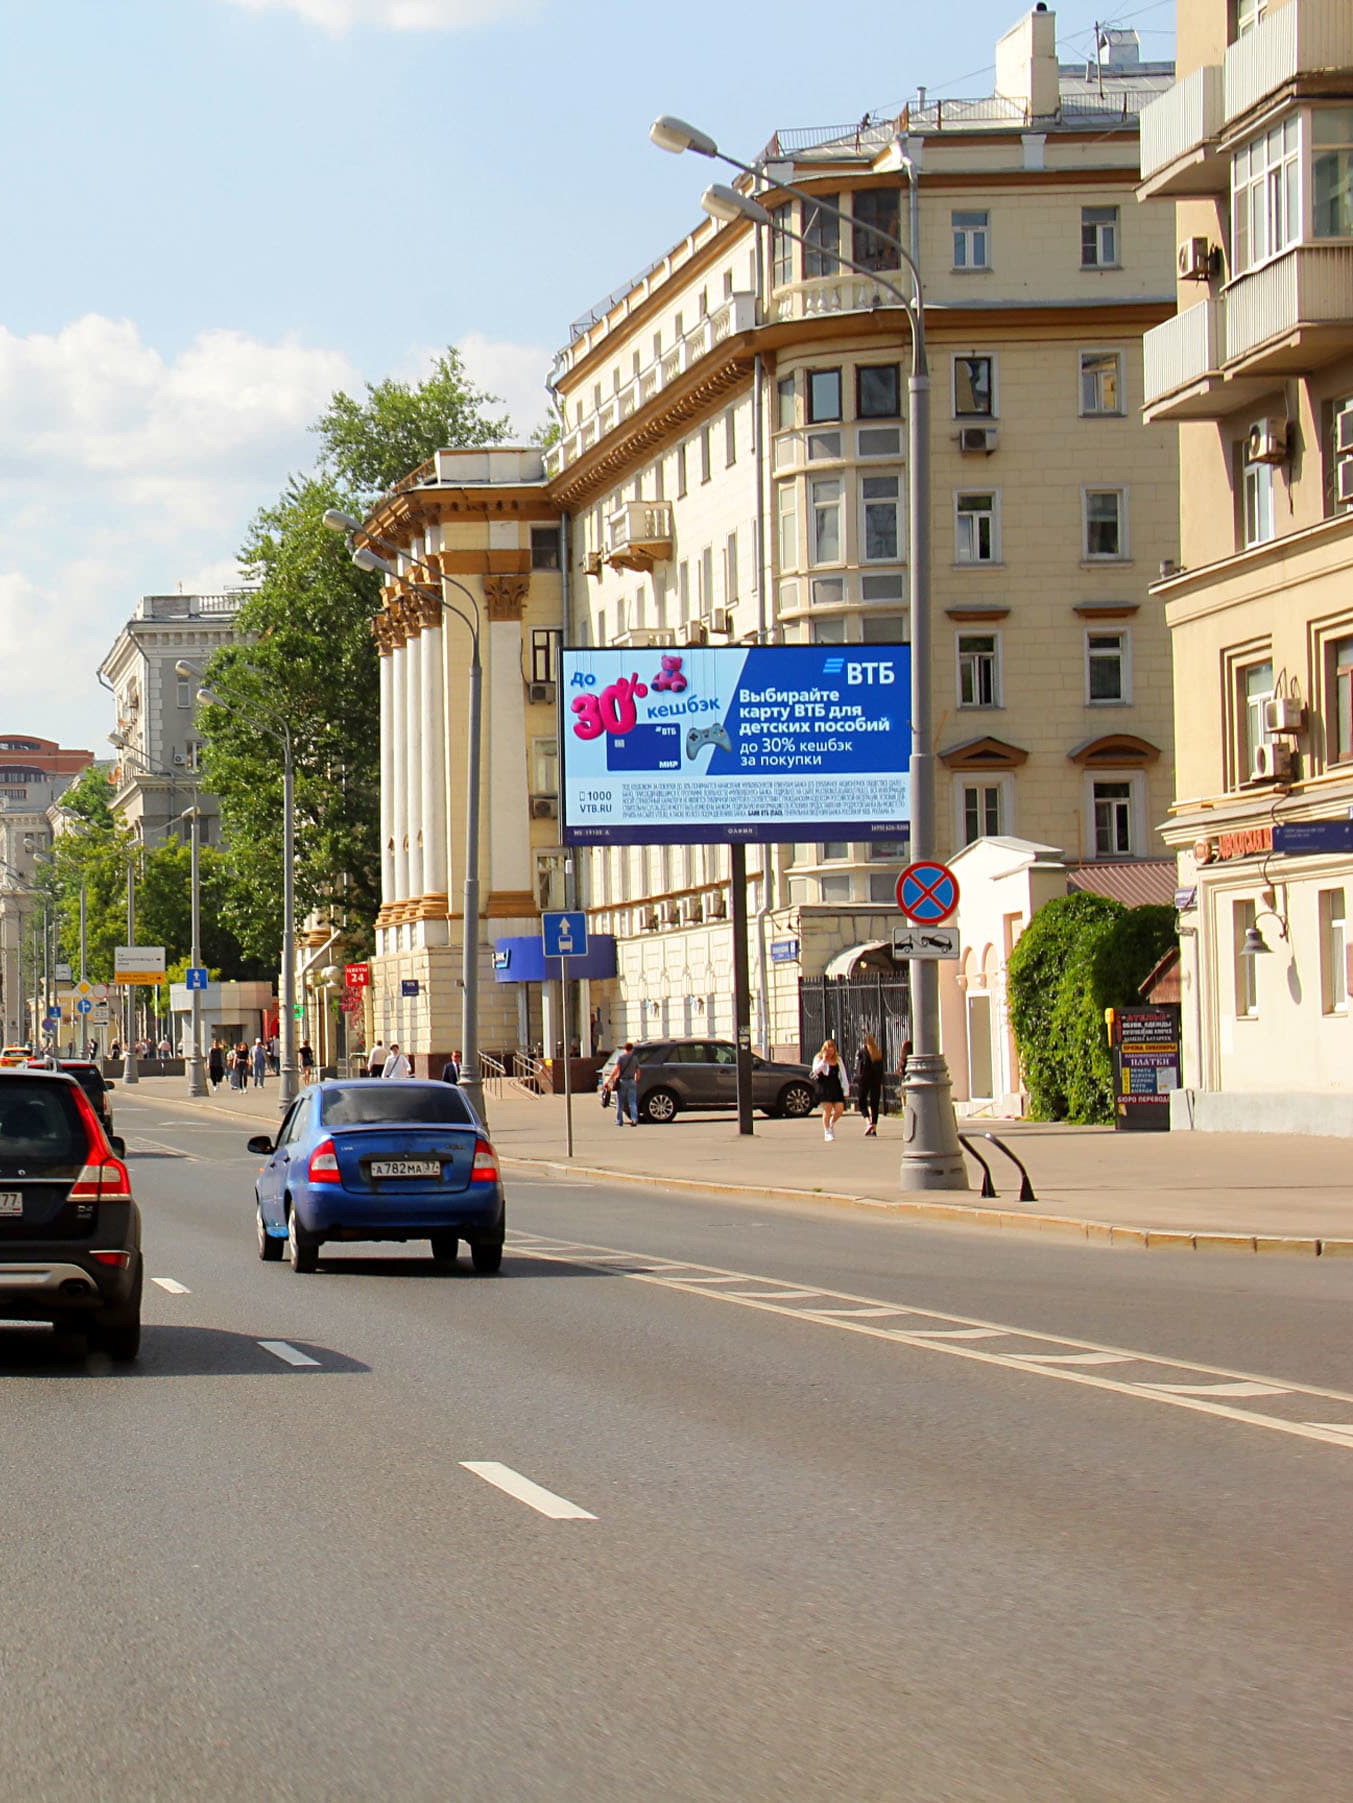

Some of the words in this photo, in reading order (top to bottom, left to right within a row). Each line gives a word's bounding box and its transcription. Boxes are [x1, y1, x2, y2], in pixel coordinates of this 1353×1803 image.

[847, 662, 895, 685] ВТБ
[739, 688, 840, 705] Выбирайте
[571, 672, 648, 740] 30%
[648, 695, 720, 719] кешбэк
[739, 706, 790, 721] карту
[794, 703, 825, 717] ВТБ
[829, 705, 862, 719] для
[739, 721, 810, 736] детских
[815, 717, 890, 732] пособий
[740, 743, 758, 755] до
[762, 737, 795, 753] 30%
[800, 738, 853, 752] кешбэк
[659, 760, 678, 768] МИР
[740, 756, 756, 766] за
[761, 755, 822, 768] покупки
[588, 791, 612, 801] 1000
[580, 804, 612, 813] VTB.RU
[351, 973, 364, 982] 24
[376, 1162, 422, 1174] А782МА
